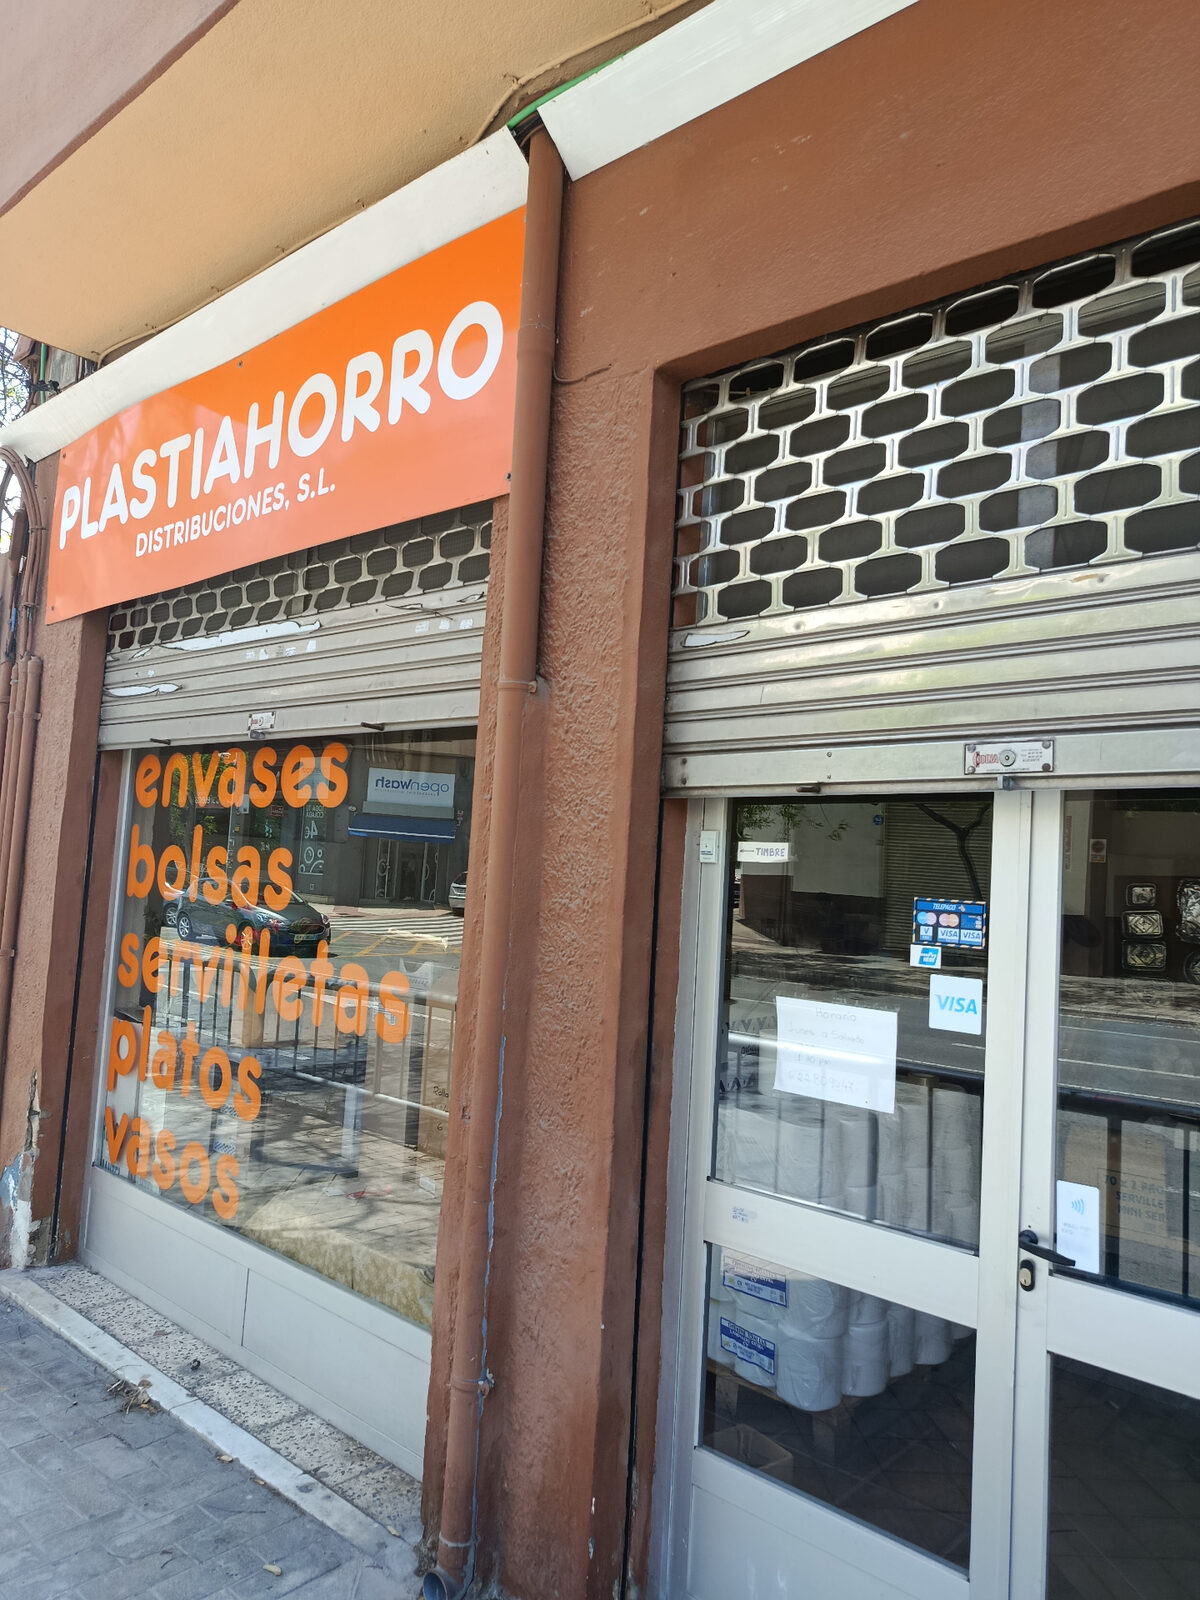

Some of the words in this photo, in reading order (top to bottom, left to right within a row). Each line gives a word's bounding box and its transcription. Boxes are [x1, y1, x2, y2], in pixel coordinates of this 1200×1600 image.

[59, 300, 504, 550] PLASTIAHORRO
[134, 487, 290, 558] DISTRIBUCIONES,
[296, 467, 336, 505] S.L.
[135, 741, 349, 809] envases
[126, 824, 294, 911] bolsas
[755, 847, 785, 857] TIMBRE
[940, 930, 958, 938] VISA
[963, 932, 981, 940] VISA
[117, 922, 411, 1045] servilletas
[934, 994, 978, 1015] VISA
[106, 1004, 262, 1121] platos
[103, 1106, 239, 1220] vasos
